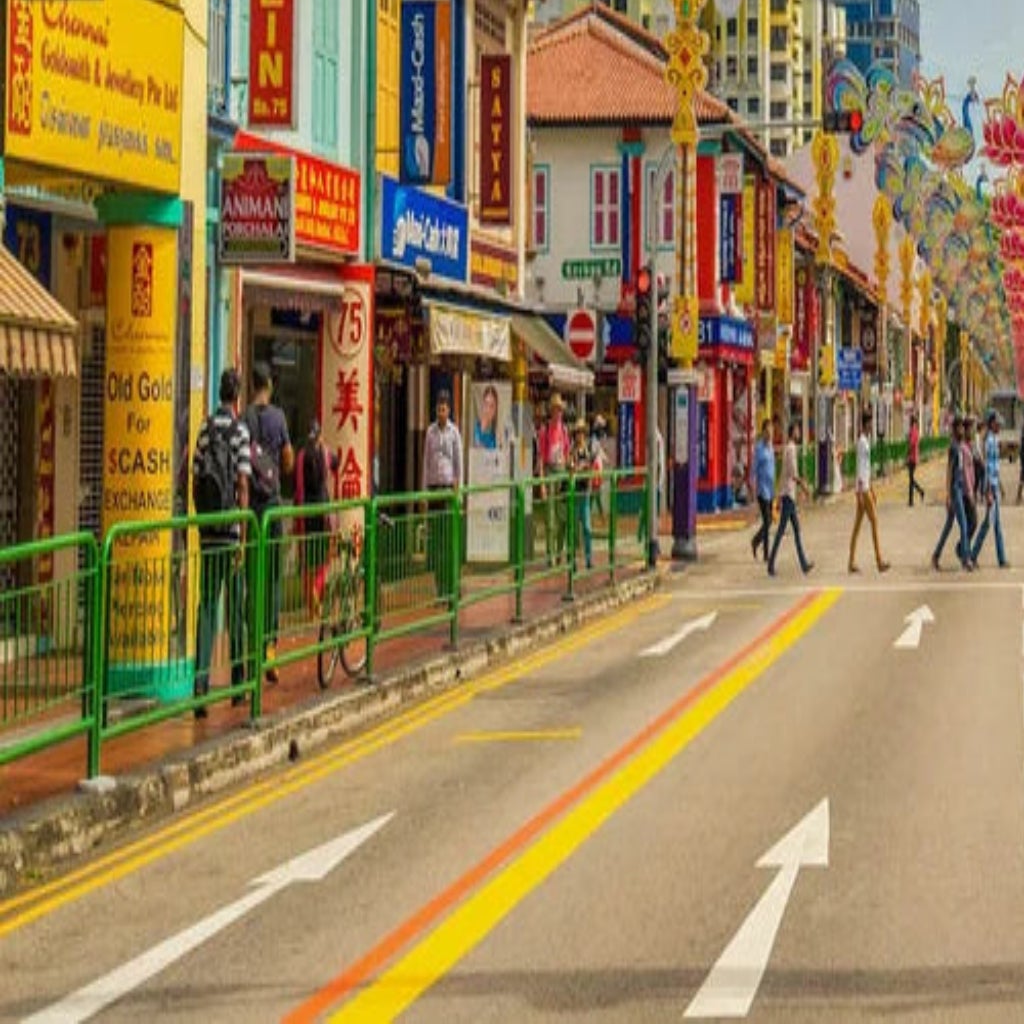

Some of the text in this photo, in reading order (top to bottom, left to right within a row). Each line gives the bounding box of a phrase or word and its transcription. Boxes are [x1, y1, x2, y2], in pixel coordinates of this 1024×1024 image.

[337, 301, 363, 347] 75
[108, 371, 173, 402] Old Gold
[126, 410, 151, 434] For
